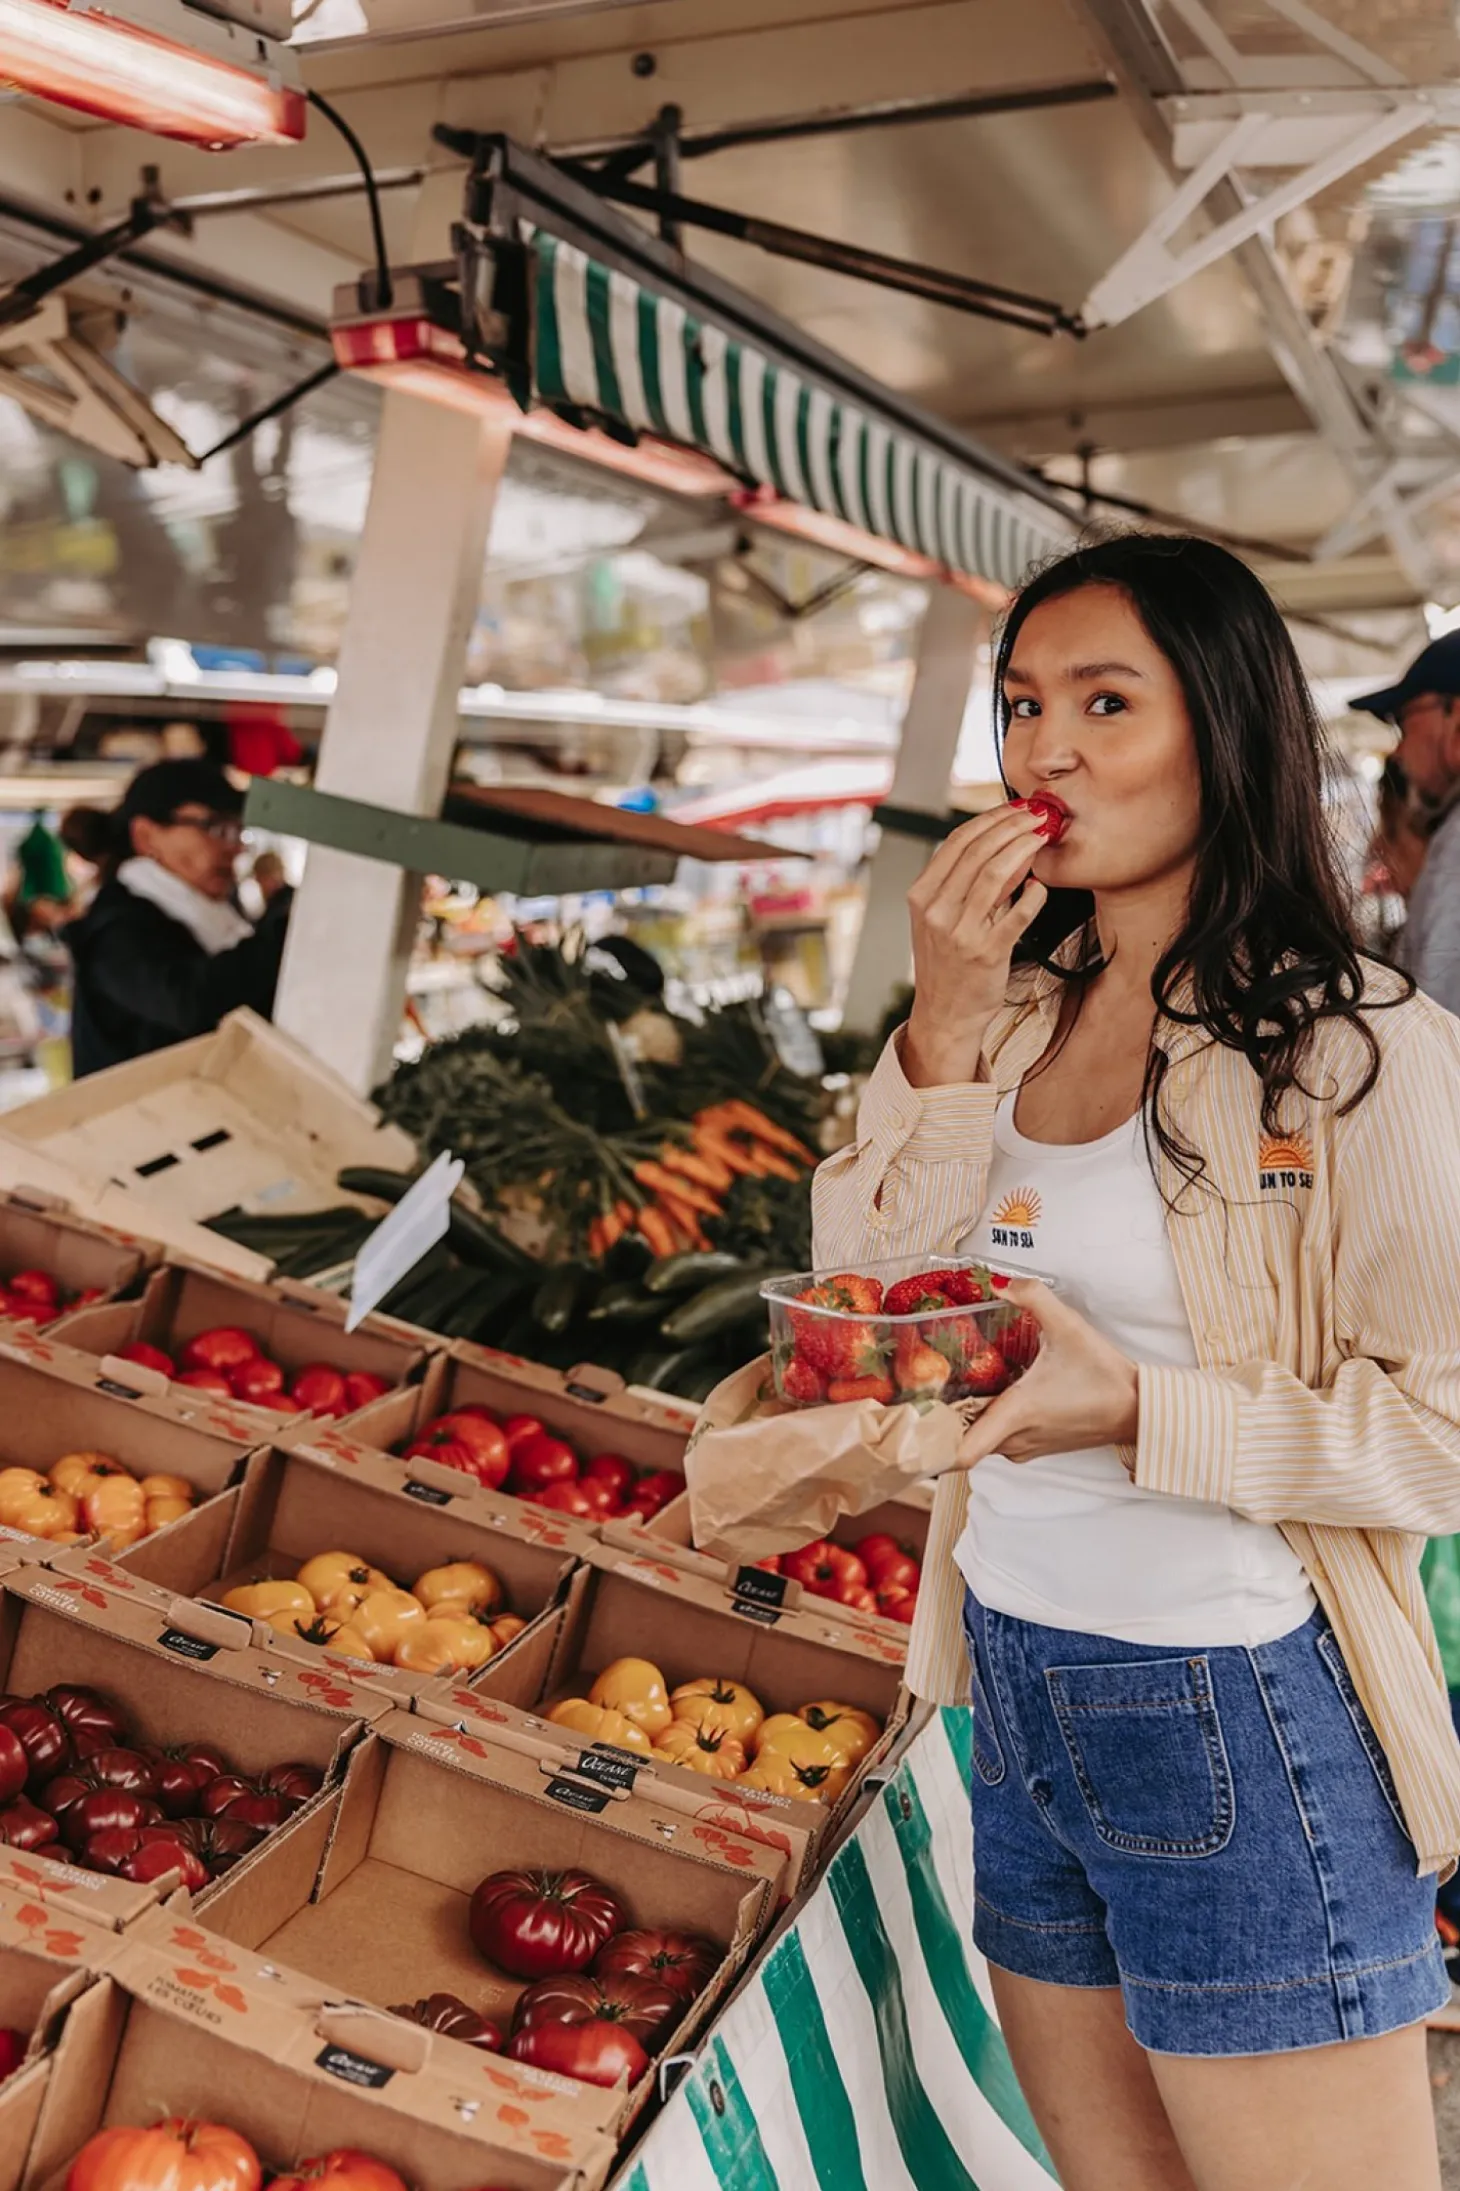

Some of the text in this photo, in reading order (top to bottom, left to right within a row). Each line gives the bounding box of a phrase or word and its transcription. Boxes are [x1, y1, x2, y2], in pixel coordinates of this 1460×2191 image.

[1260, 1172, 1314, 1189] UN TO SE
[991, 1227, 1034, 1248] SUN TO SEA
